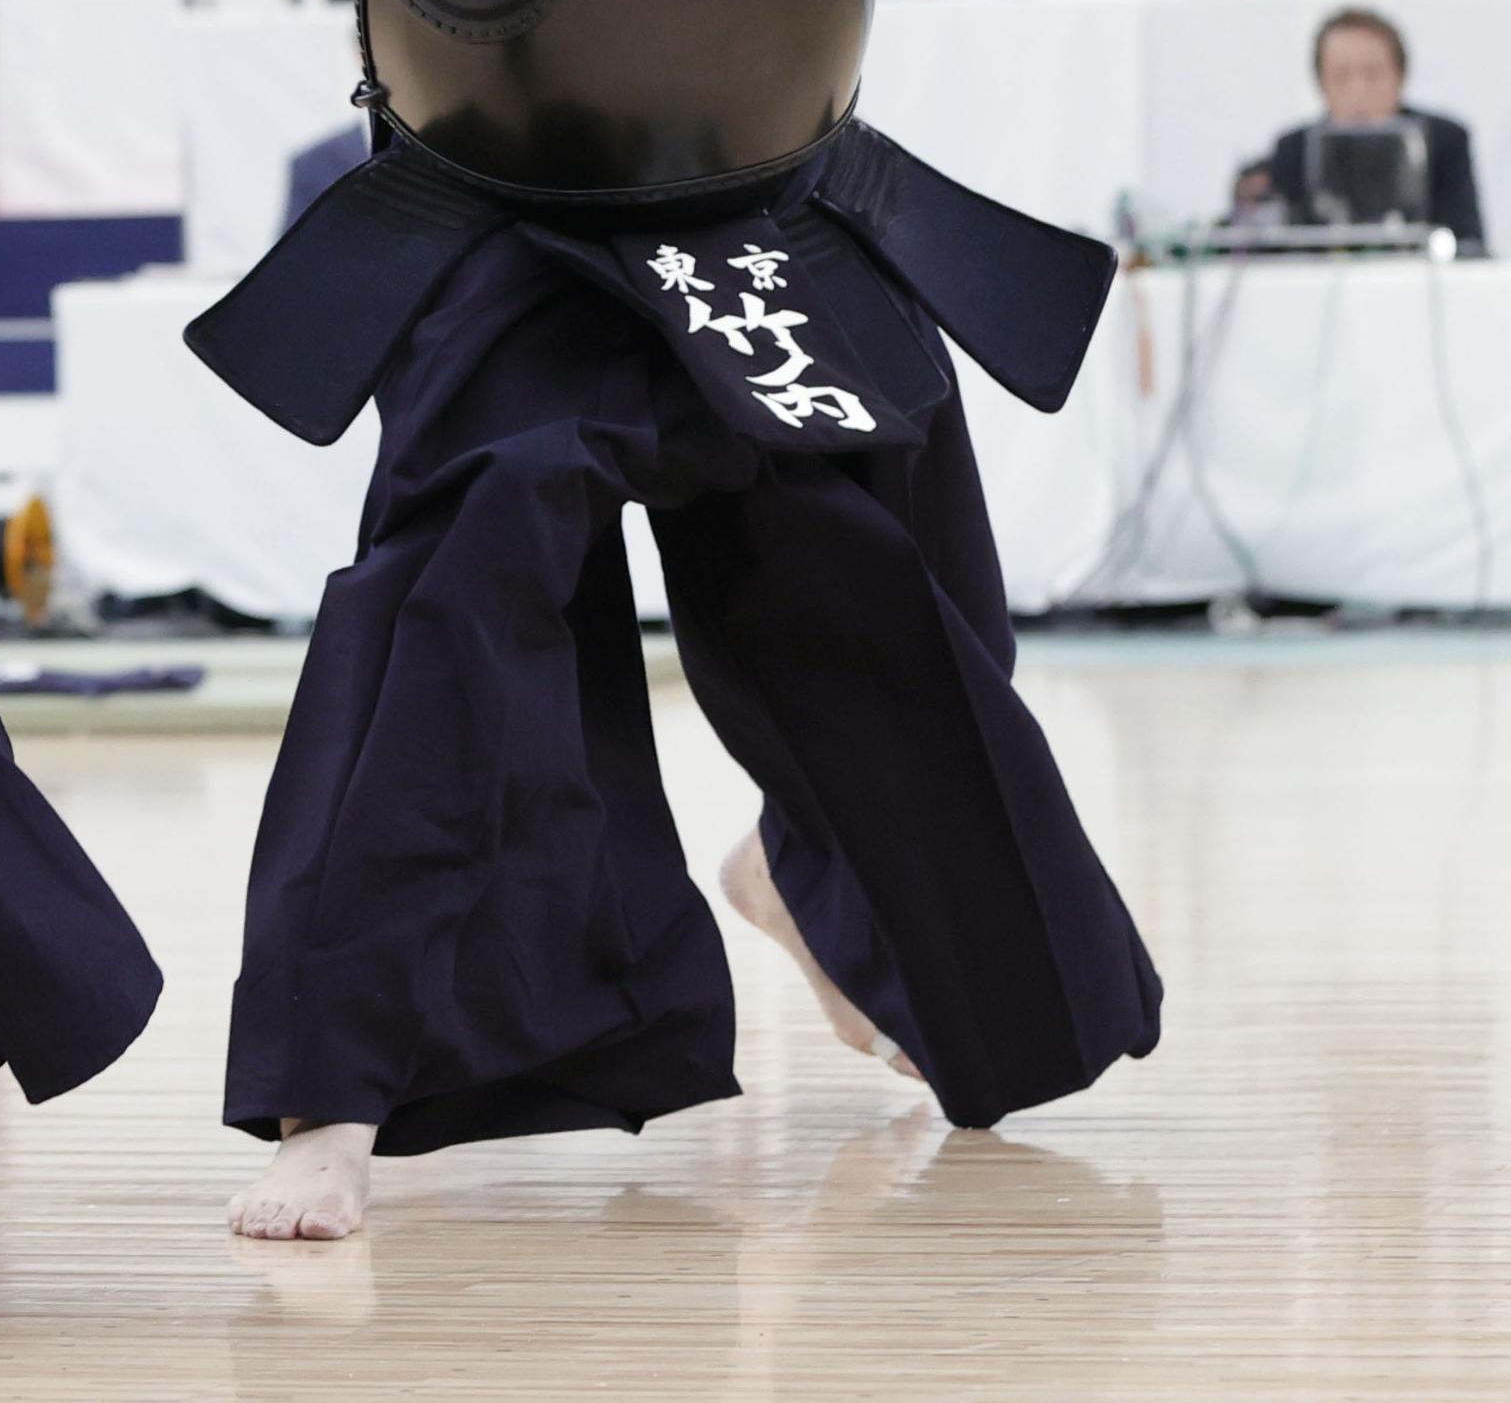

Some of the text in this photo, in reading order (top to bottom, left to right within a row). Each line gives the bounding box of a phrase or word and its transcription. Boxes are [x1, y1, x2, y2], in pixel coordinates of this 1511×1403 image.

[646, 244, 790, 293] 東京
[685, 292, 877, 432] 竹ノ内
